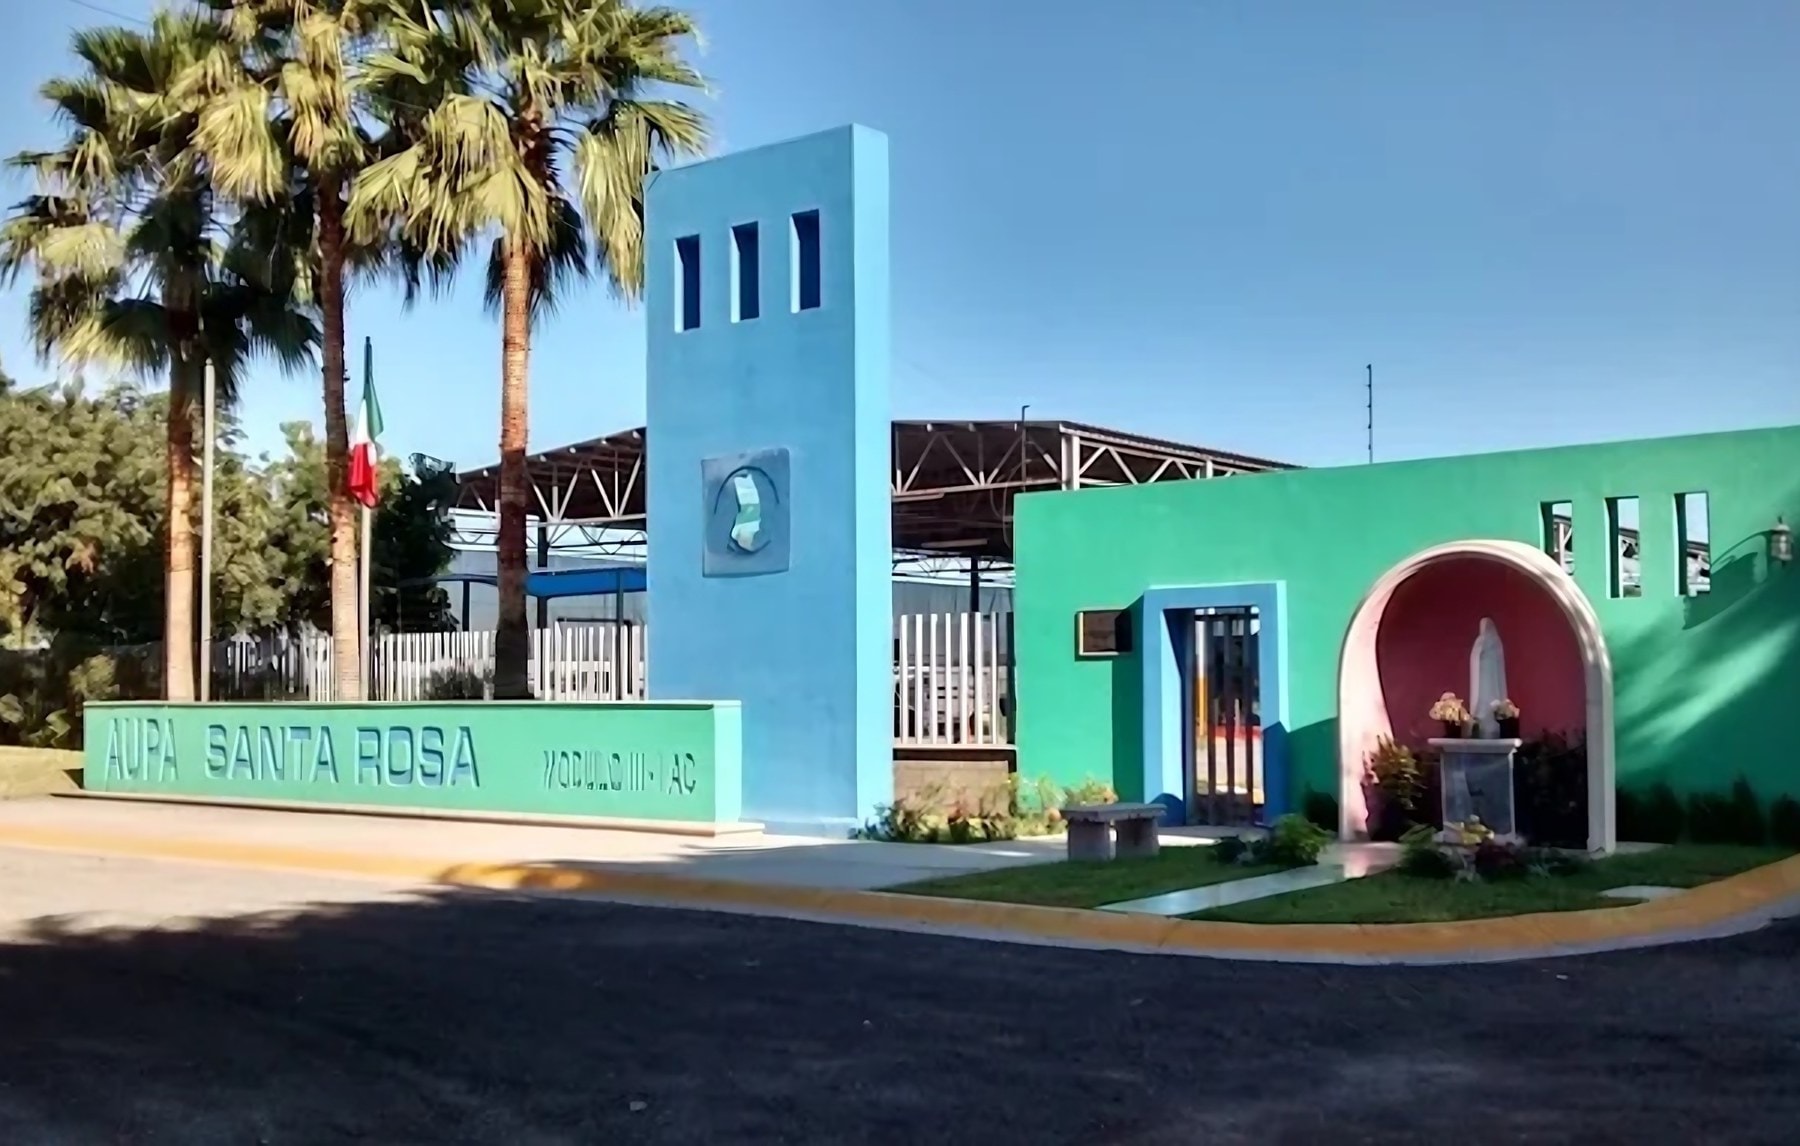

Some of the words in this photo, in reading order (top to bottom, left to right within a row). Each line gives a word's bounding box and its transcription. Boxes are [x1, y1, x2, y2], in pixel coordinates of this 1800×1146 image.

[104, 718, 179, 782] AUPA
[205, 724, 339, 784] SANTA
[354, 725, 480, 788] ROSA
